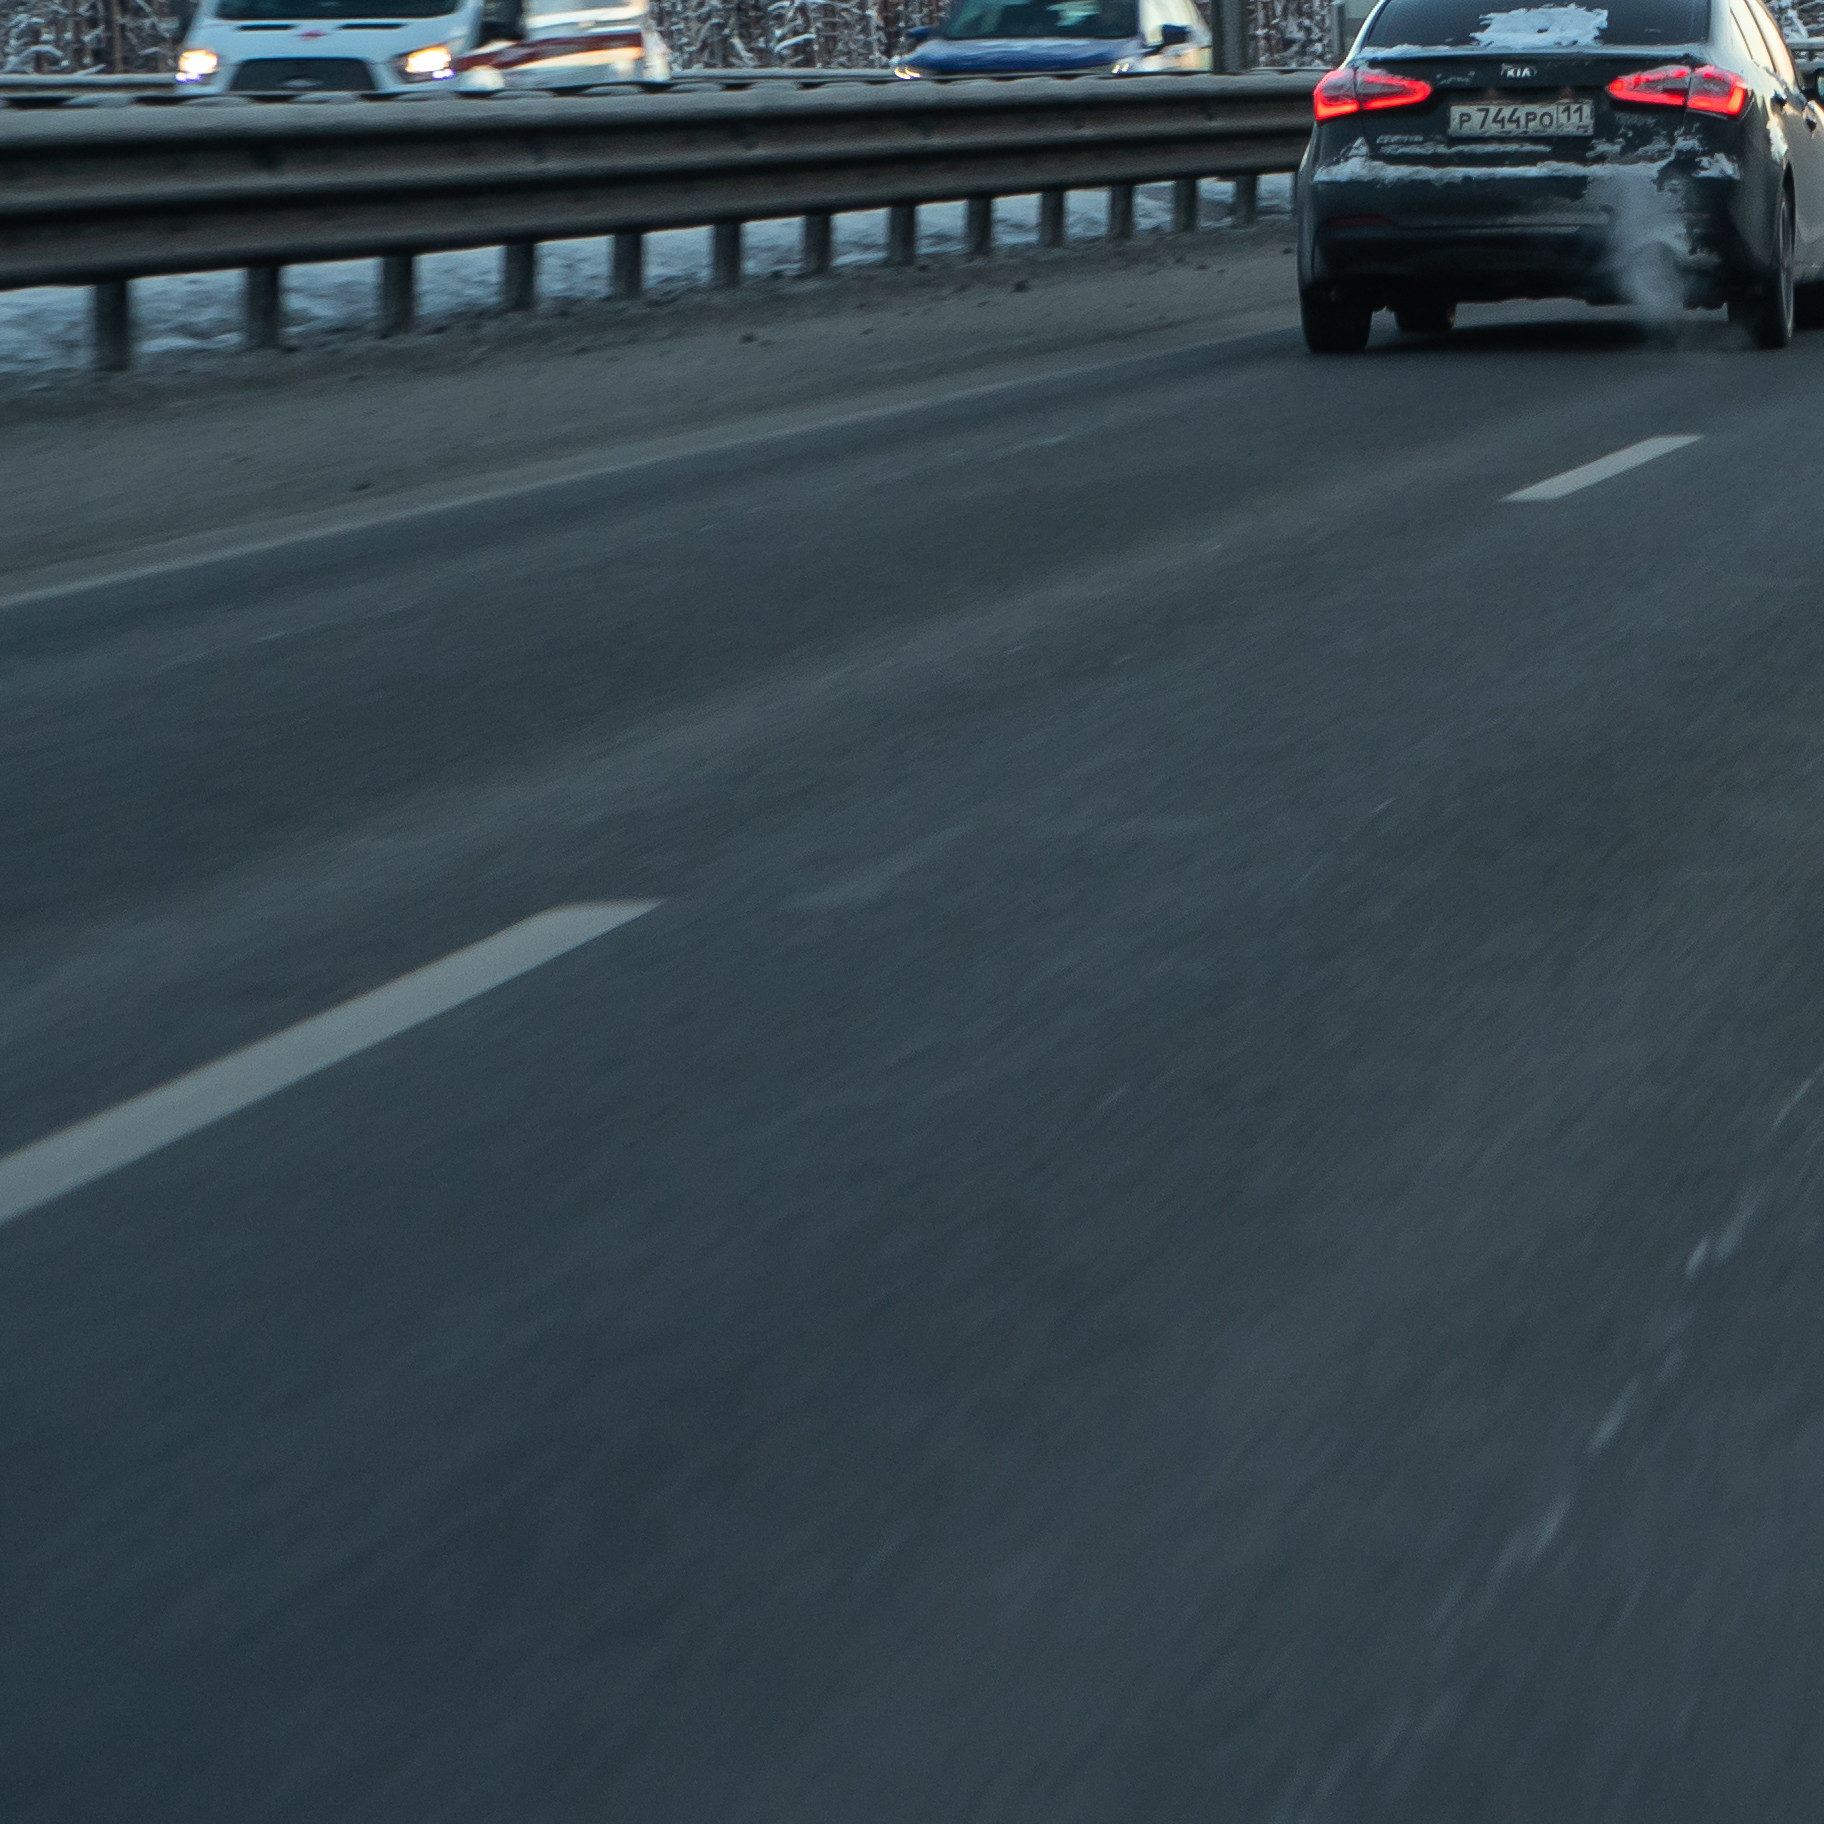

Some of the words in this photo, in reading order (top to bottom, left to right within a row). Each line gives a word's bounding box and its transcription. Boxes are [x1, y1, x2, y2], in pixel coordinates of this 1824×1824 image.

[1506, 67, 1532, 78] KIA
[1459, 107, 1554, 130] Р744РО
[1560, 105, 1585, 123] 11
